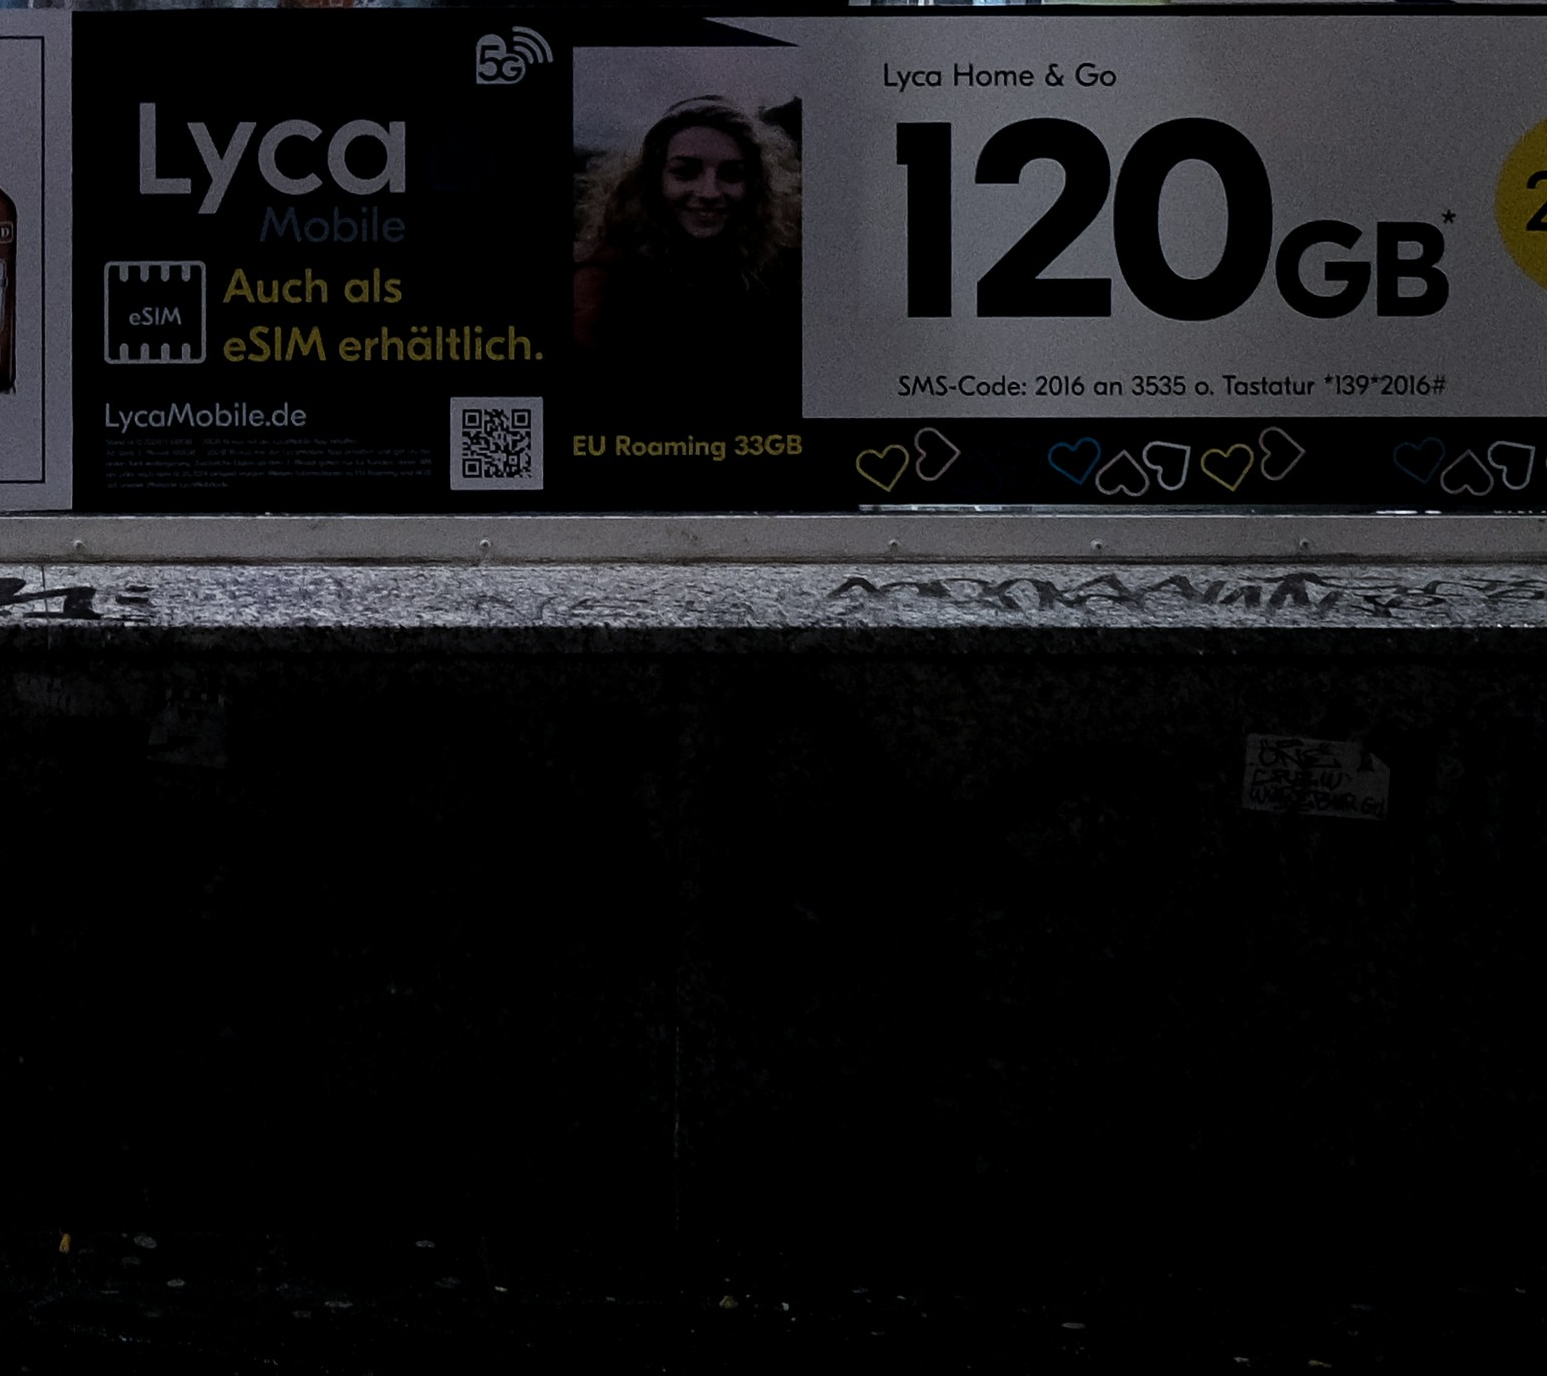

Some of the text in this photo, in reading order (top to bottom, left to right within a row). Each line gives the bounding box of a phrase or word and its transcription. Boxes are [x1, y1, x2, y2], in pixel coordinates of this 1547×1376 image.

[477, 44, 525, 83] 5G
[882, 62, 1117, 93] Lyca Home & Go
[138, 100, 407, 215] Lyca
[259, 205, 407, 245] Mobile
[223, 268, 403, 304] Auch als
[128, 306, 182, 328] eSIM
[223, 325, 545, 364] eSIM erhältlich.
[897, 372, 1028, 399] SMS-Code:
[1034, 373, 1085, 399] 2016
[1094, 379, 1125, 398] an
[1131, 373, 1187, 399] 3535
[1194, 379, 1215, 398] o.
[1221, 373, 1316, 398] Tastatur
[104, 401, 307, 435] LycaMobile.de
[573, 433, 803, 463] EU Roaming 33GB
